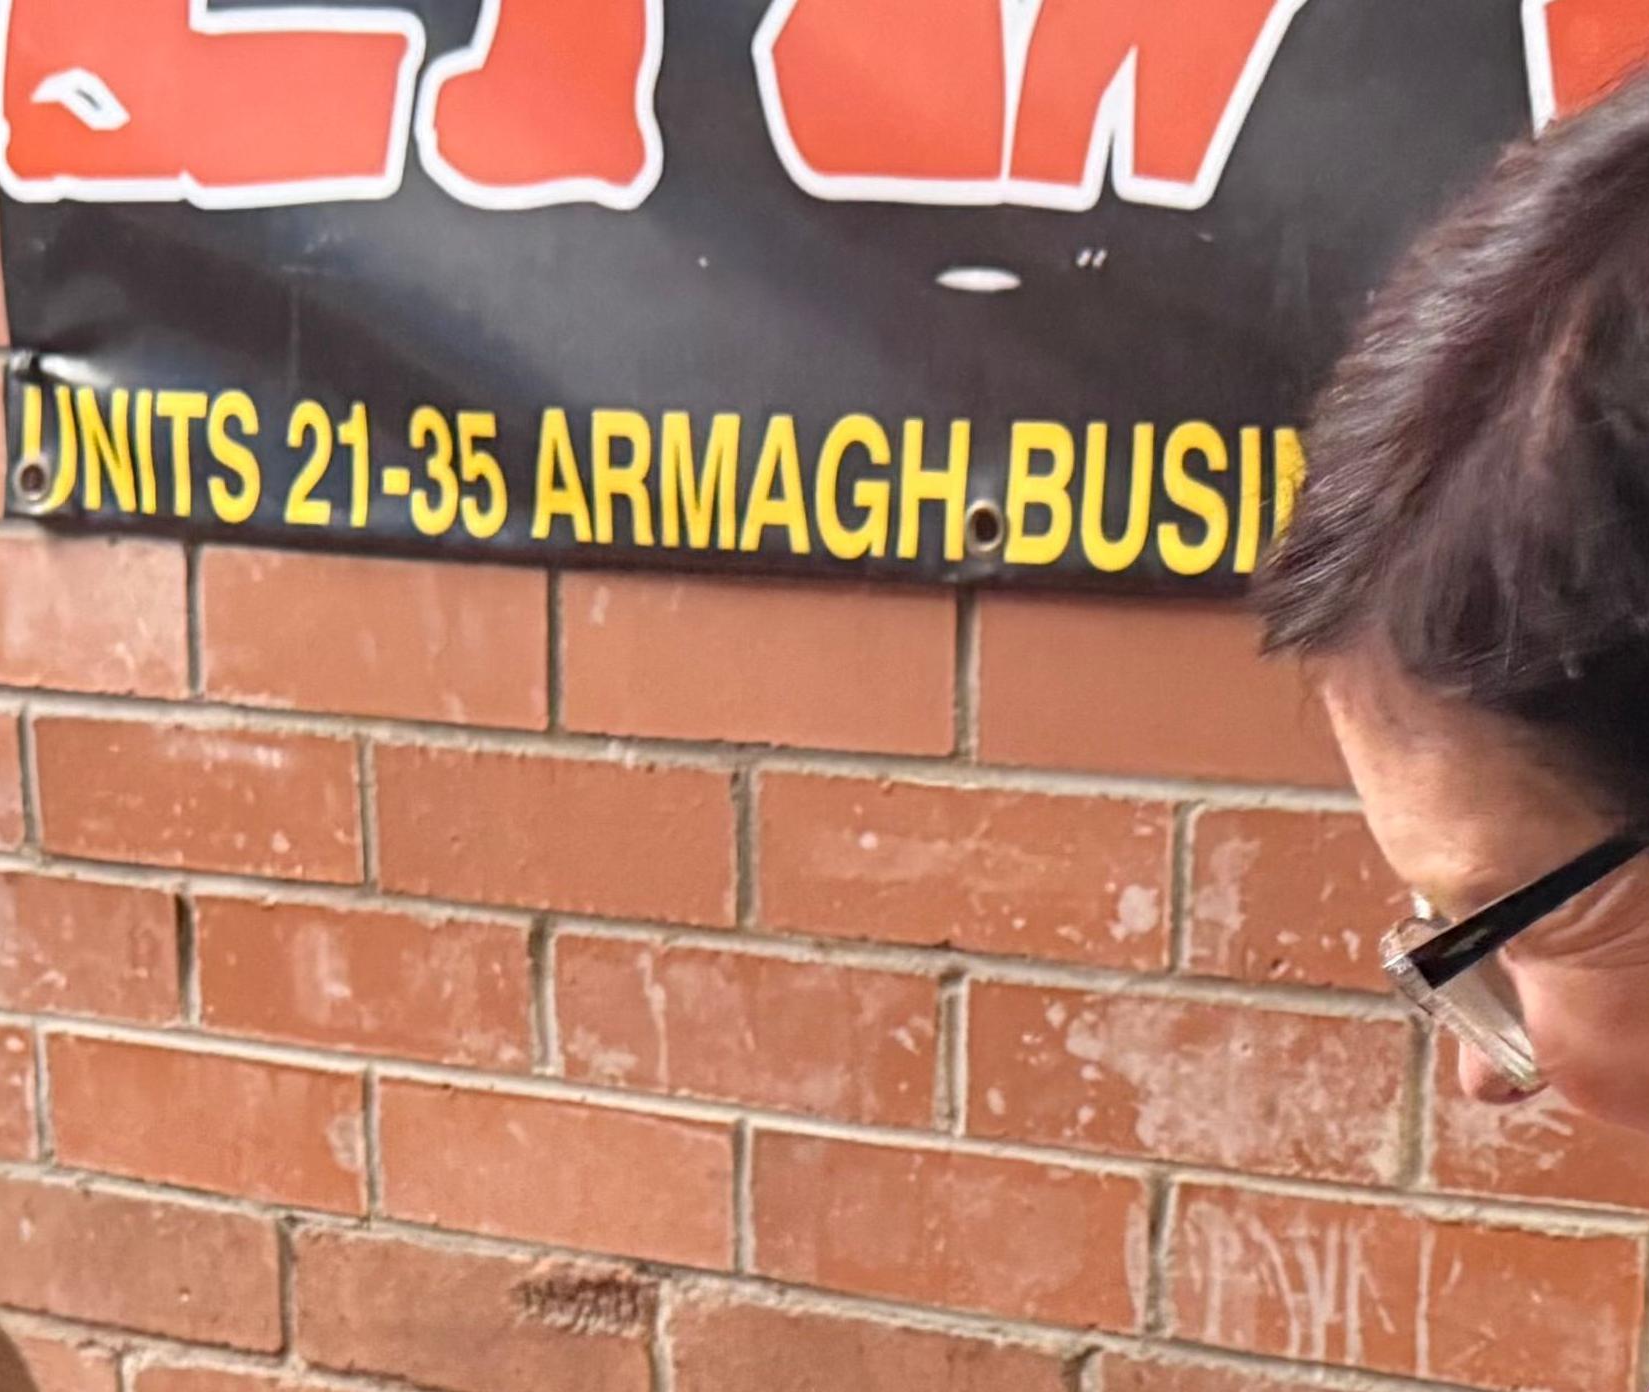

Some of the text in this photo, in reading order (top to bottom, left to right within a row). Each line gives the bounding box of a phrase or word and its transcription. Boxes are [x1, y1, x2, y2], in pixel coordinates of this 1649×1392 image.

[22, 384, 261, 524] UNITS
[284, 399, 508, 538] 21-35
[530, 407, 973, 562] ARMAGH
